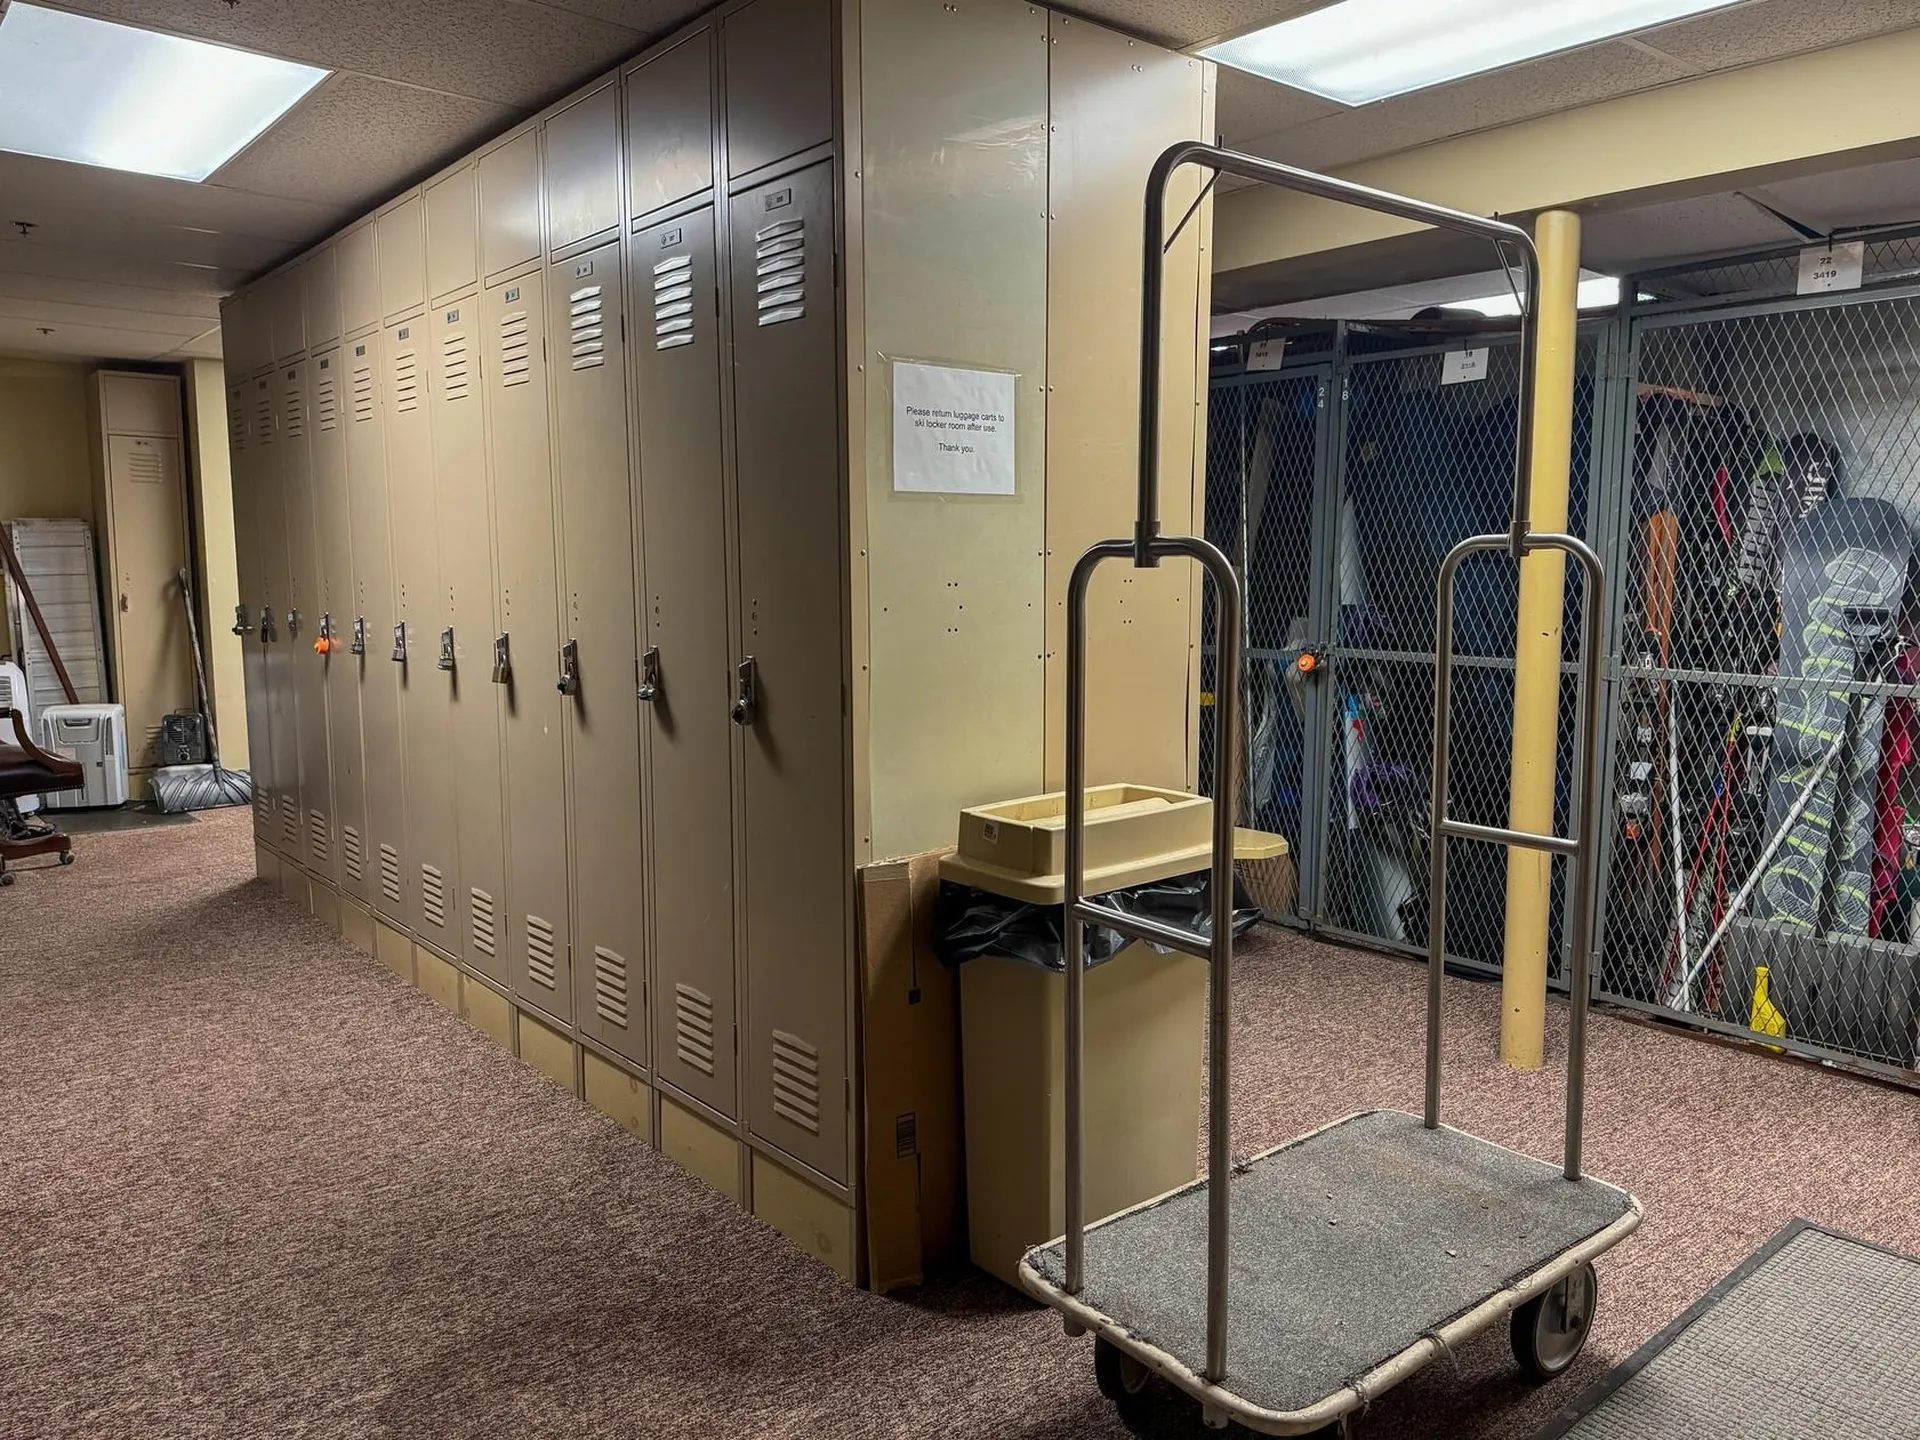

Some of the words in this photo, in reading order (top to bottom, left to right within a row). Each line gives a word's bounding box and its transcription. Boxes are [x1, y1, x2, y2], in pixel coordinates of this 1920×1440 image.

[1820, 256, 1832, 265] 22
[1813, 270, 1837, 280] 3419
[906, 405, 930, 417] Please
[932, 409, 952, 418] return
[953, 410, 980, 422] luggage
[981, 413, 997, 421] carts
[998, 414, 1004, 422] to
[914, 419, 925, 427] ski
[926, 419, 947, 429] locker
[948, 422, 966, 430] room
[967, 422, 982, 431] after
[983, 425, 996, 433] use.
[939, 442, 960, 452] Thank
